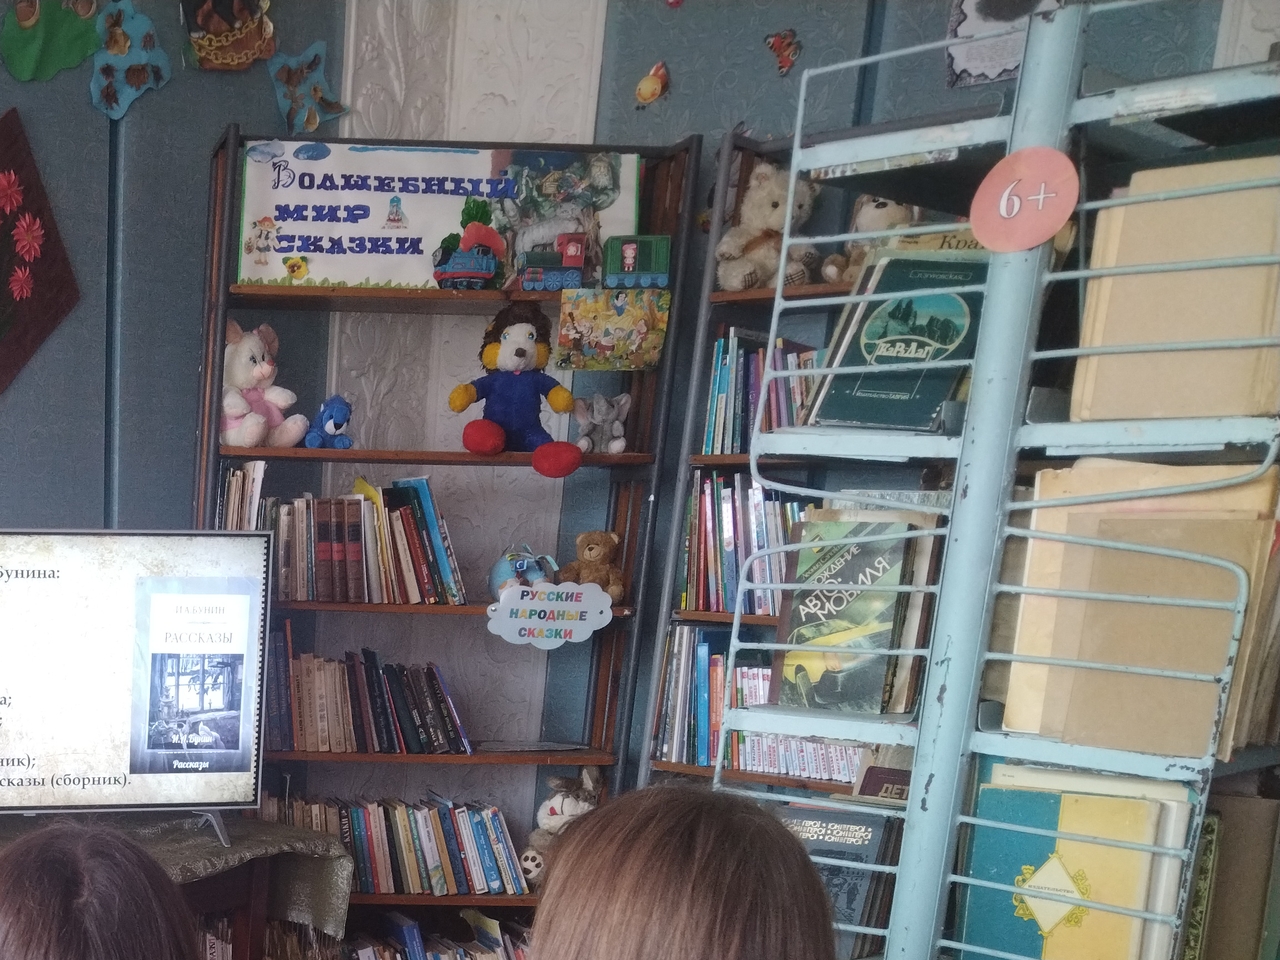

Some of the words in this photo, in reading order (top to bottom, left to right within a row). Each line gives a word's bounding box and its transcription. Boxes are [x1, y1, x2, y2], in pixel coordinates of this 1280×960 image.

[999, 179, 1057, 219] 6+
[275, 204, 370, 223] МИР
[274, 235, 424, 256] СКАЗКИ
[938, 234, 985, 250] Кра
[520, 590, 584, 603] РУССКИЕ
[509, 607, 588, 622] НАРОДНЫЕ
[165, 632, 233, 643] РАССКАЗЫ
[518, 627, 573, 639] СКАЗКИ
[172, 759, 209, 770] Рассказы
[50, 773, 131, 789] (сборник).
